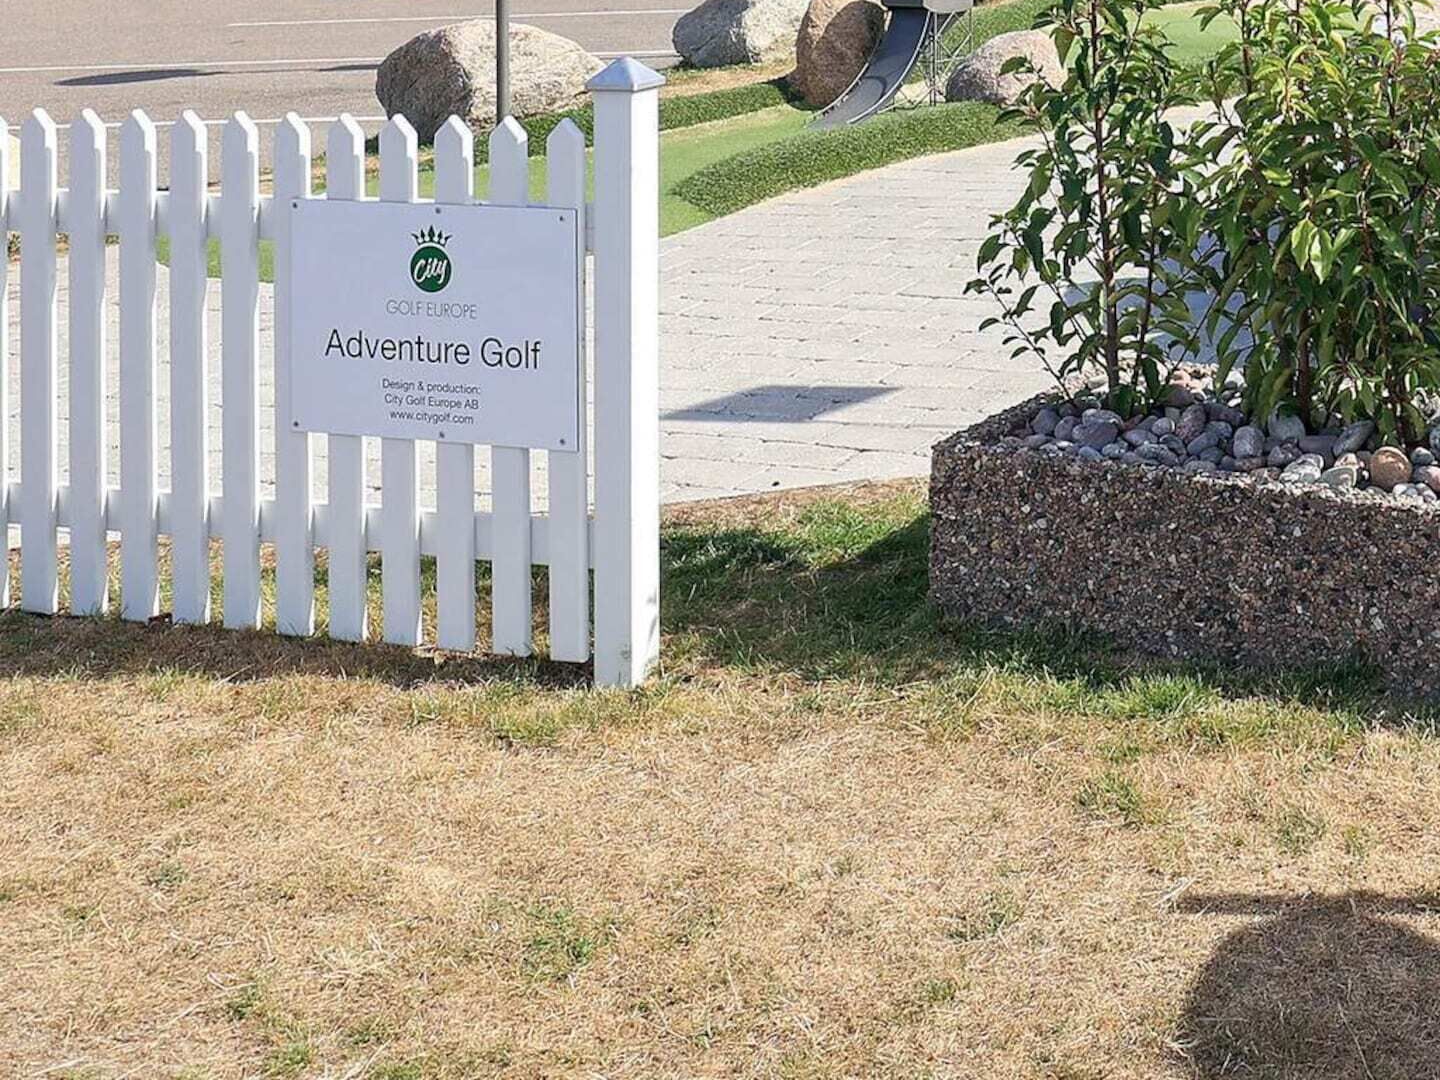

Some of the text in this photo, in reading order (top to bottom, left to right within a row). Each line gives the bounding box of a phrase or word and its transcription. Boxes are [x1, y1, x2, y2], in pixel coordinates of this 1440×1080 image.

[414, 257, 448, 284] City
[386, 299, 478, 320] GOLF EUROPE
[324, 328, 542, 369] Adventure Golf
[382, 378, 481, 395] Design & production:
[384, 393, 479, 410] City Golf Europe AB
[389, 410, 474, 425] www.citygolf.com
